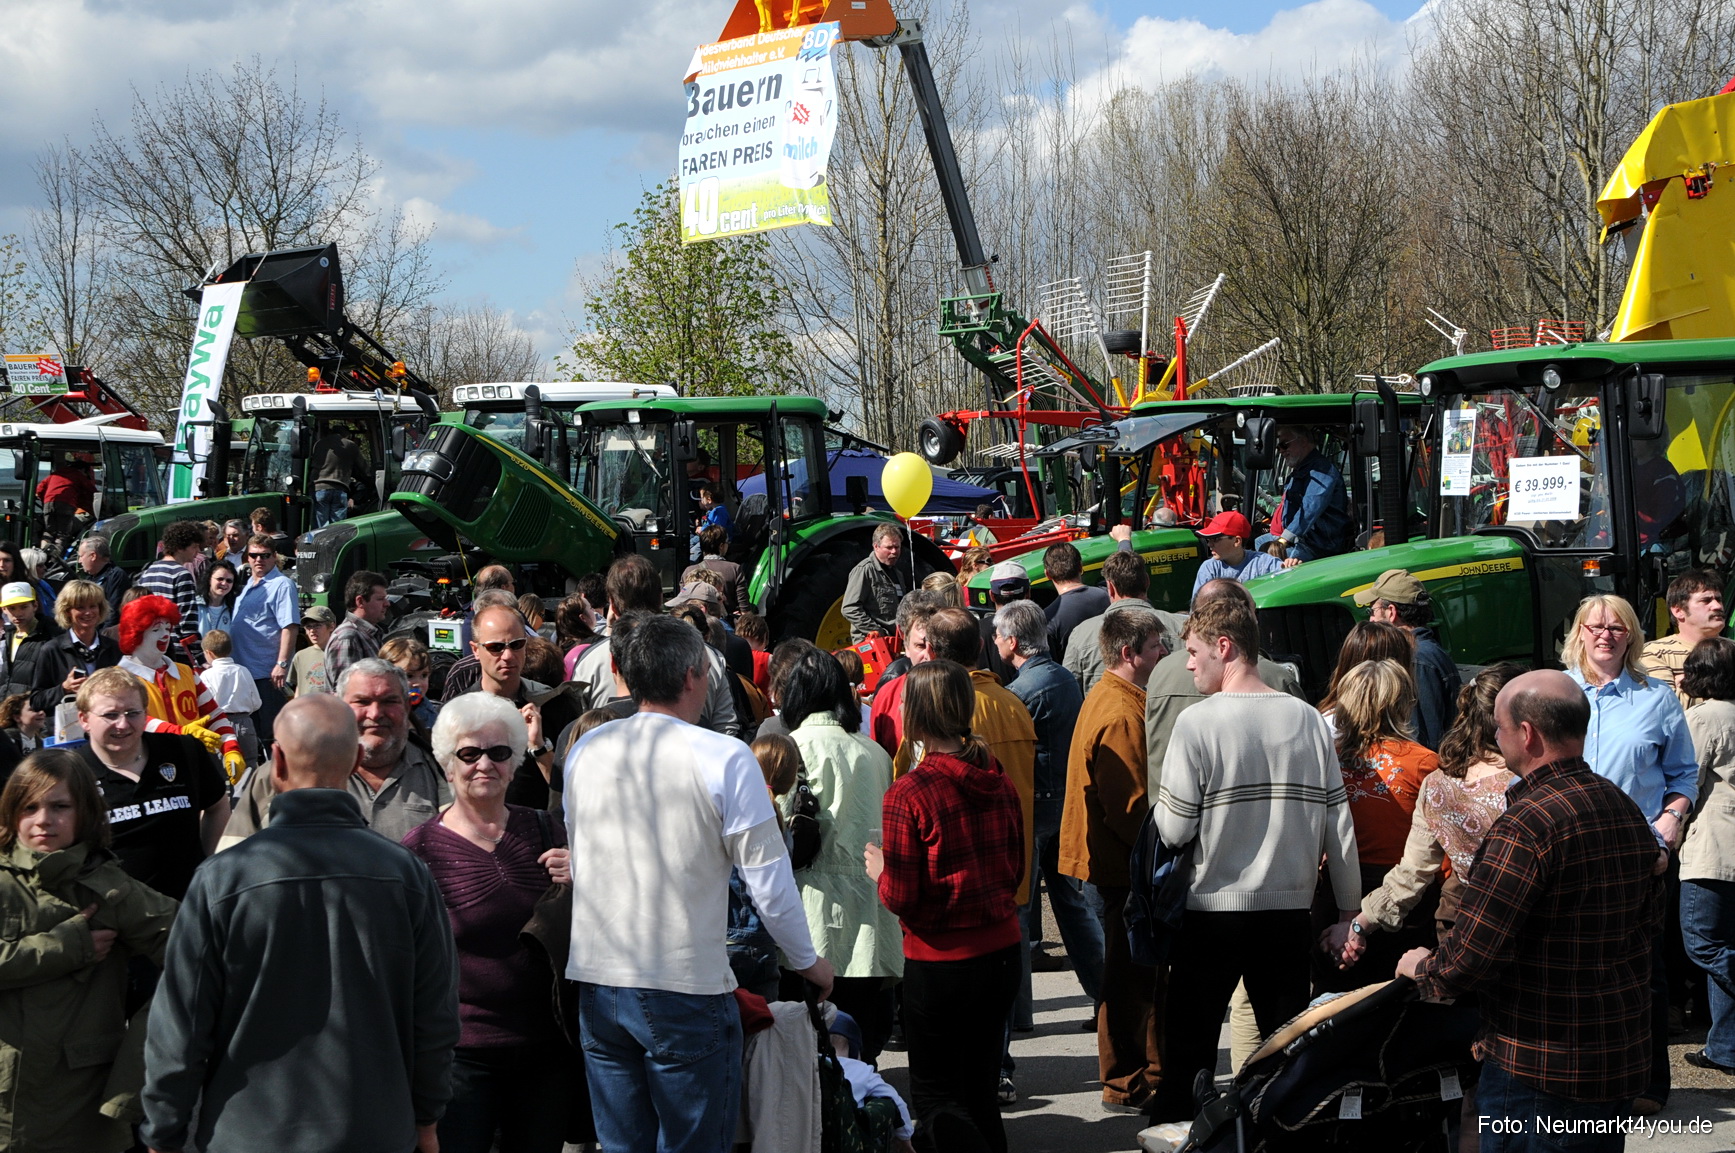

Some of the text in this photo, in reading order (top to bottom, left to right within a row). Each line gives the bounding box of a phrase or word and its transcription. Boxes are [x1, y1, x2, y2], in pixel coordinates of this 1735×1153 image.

[758, 27, 806, 45] Deutscher
[743, 115, 776, 134] einen
[732, 140, 773, 166] PREIS
[683, 176, 720, 237] 40
[719, 202, 759, 233] cent
[763, 209, 776, 222] pro
[778, 204, 797, 217] Liter
[14, 383, 51, 394] 40 Cent
[1514, 480, 1522, 493] €
[1159, 552, 1190, 563] DEERE
[1459, 562, 1512, 576] JOHN DEERE
[105, 795, 192, 824] LEGE LEAGUE
